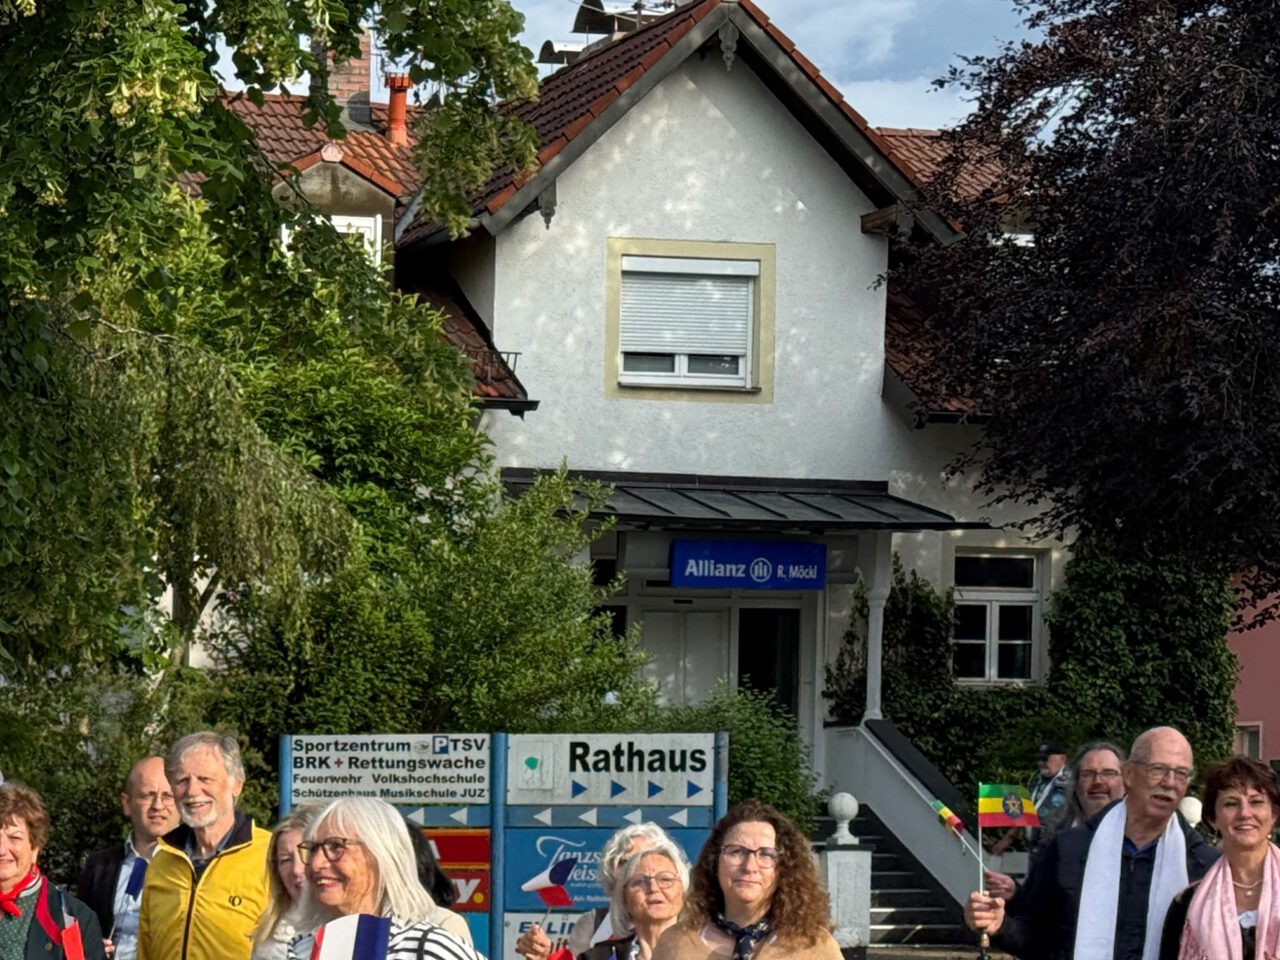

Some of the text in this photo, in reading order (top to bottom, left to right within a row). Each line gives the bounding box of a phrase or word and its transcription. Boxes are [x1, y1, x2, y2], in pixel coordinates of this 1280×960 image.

[684, 559, 746, 577] Allianz
[788, 564, 817, 579] Möckl
[293, 739, 411, 754] Sportzentrum
[450, 738, 486, 750] TSV
[293, 756, 486, 772] BRK Rettungswache
[569, 741, 707, 773] Rathaus
[293, 773, 485, 784] Feuerwehr Volkshochschule
[380, 788, 457, 798] Musikschule
[460, 788, 486, 798] JUZ
